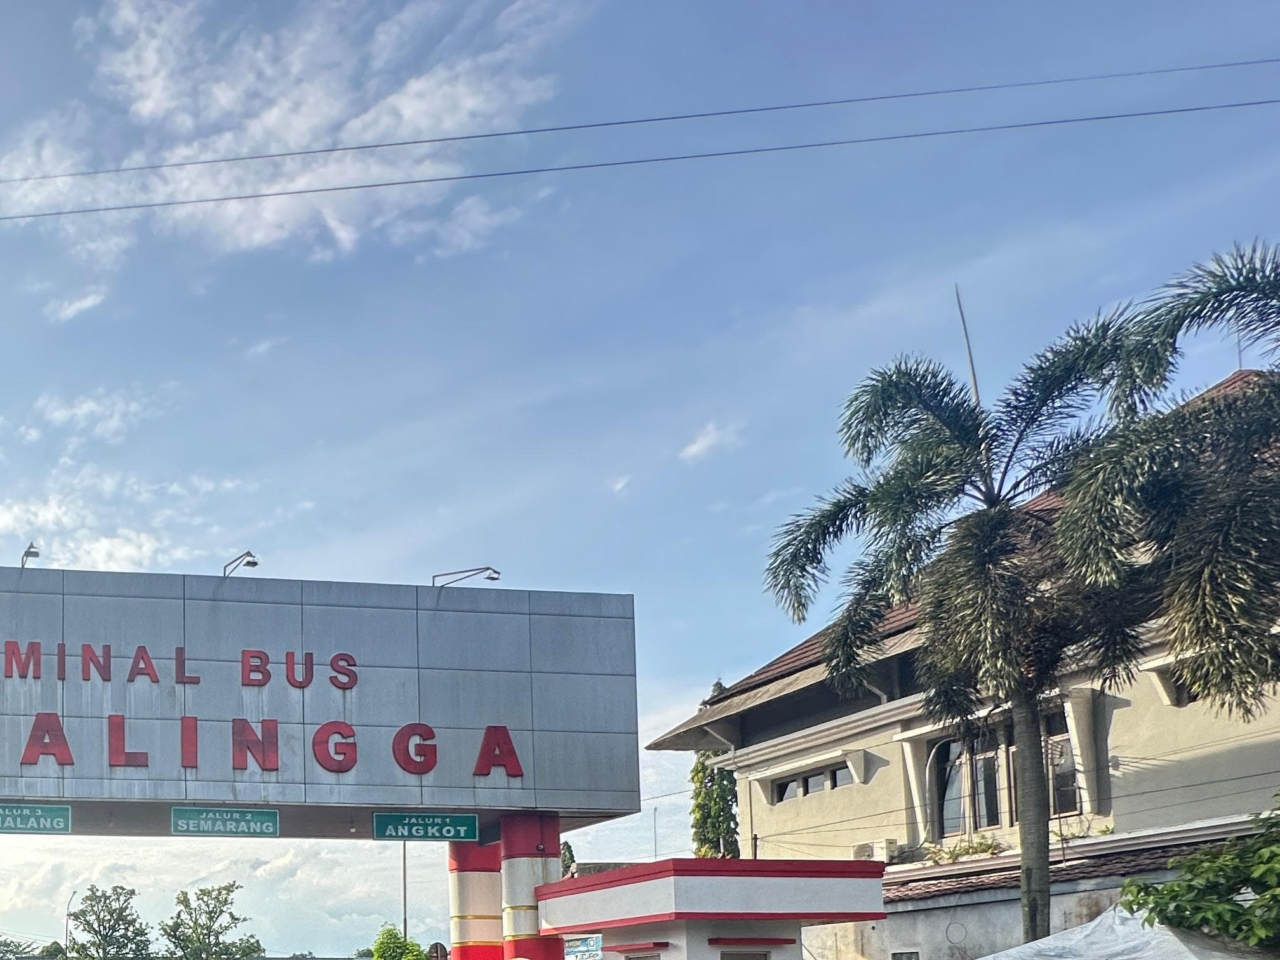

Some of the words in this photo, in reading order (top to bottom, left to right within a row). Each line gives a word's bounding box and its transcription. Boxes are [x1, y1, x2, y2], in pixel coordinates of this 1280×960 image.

[241, 649, 359, 691] BUS
[177, 820, 274, 833] SEMARANG
[385, 825, 470, 837] ANGKOT
